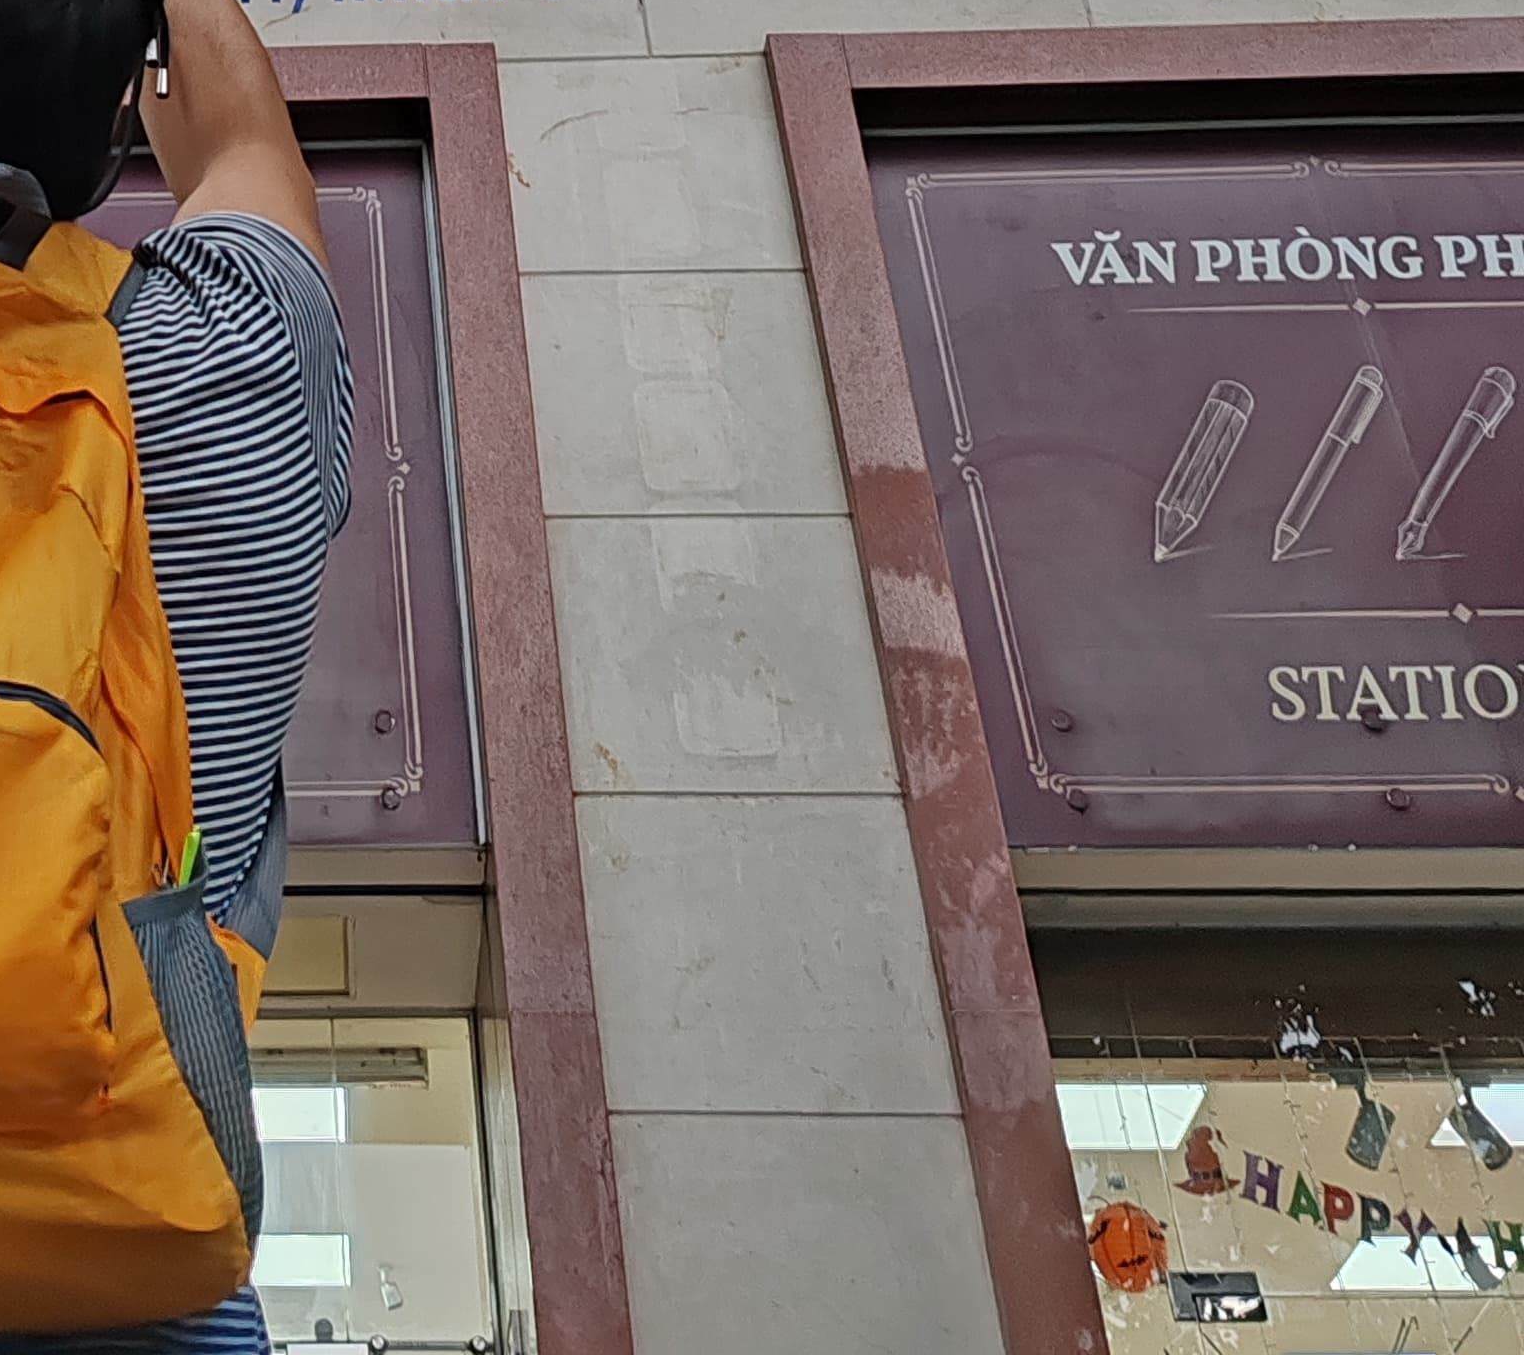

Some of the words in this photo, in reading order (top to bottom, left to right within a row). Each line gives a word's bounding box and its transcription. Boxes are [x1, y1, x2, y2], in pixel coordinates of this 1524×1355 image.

[1050, 229, 1177, 286] VĂN
[1190, 225, 1425, 284] PHÒNG
[1267, 663, 1524, 723] STATIO
[1239, 1149, 1436, 1267] HAPPY
